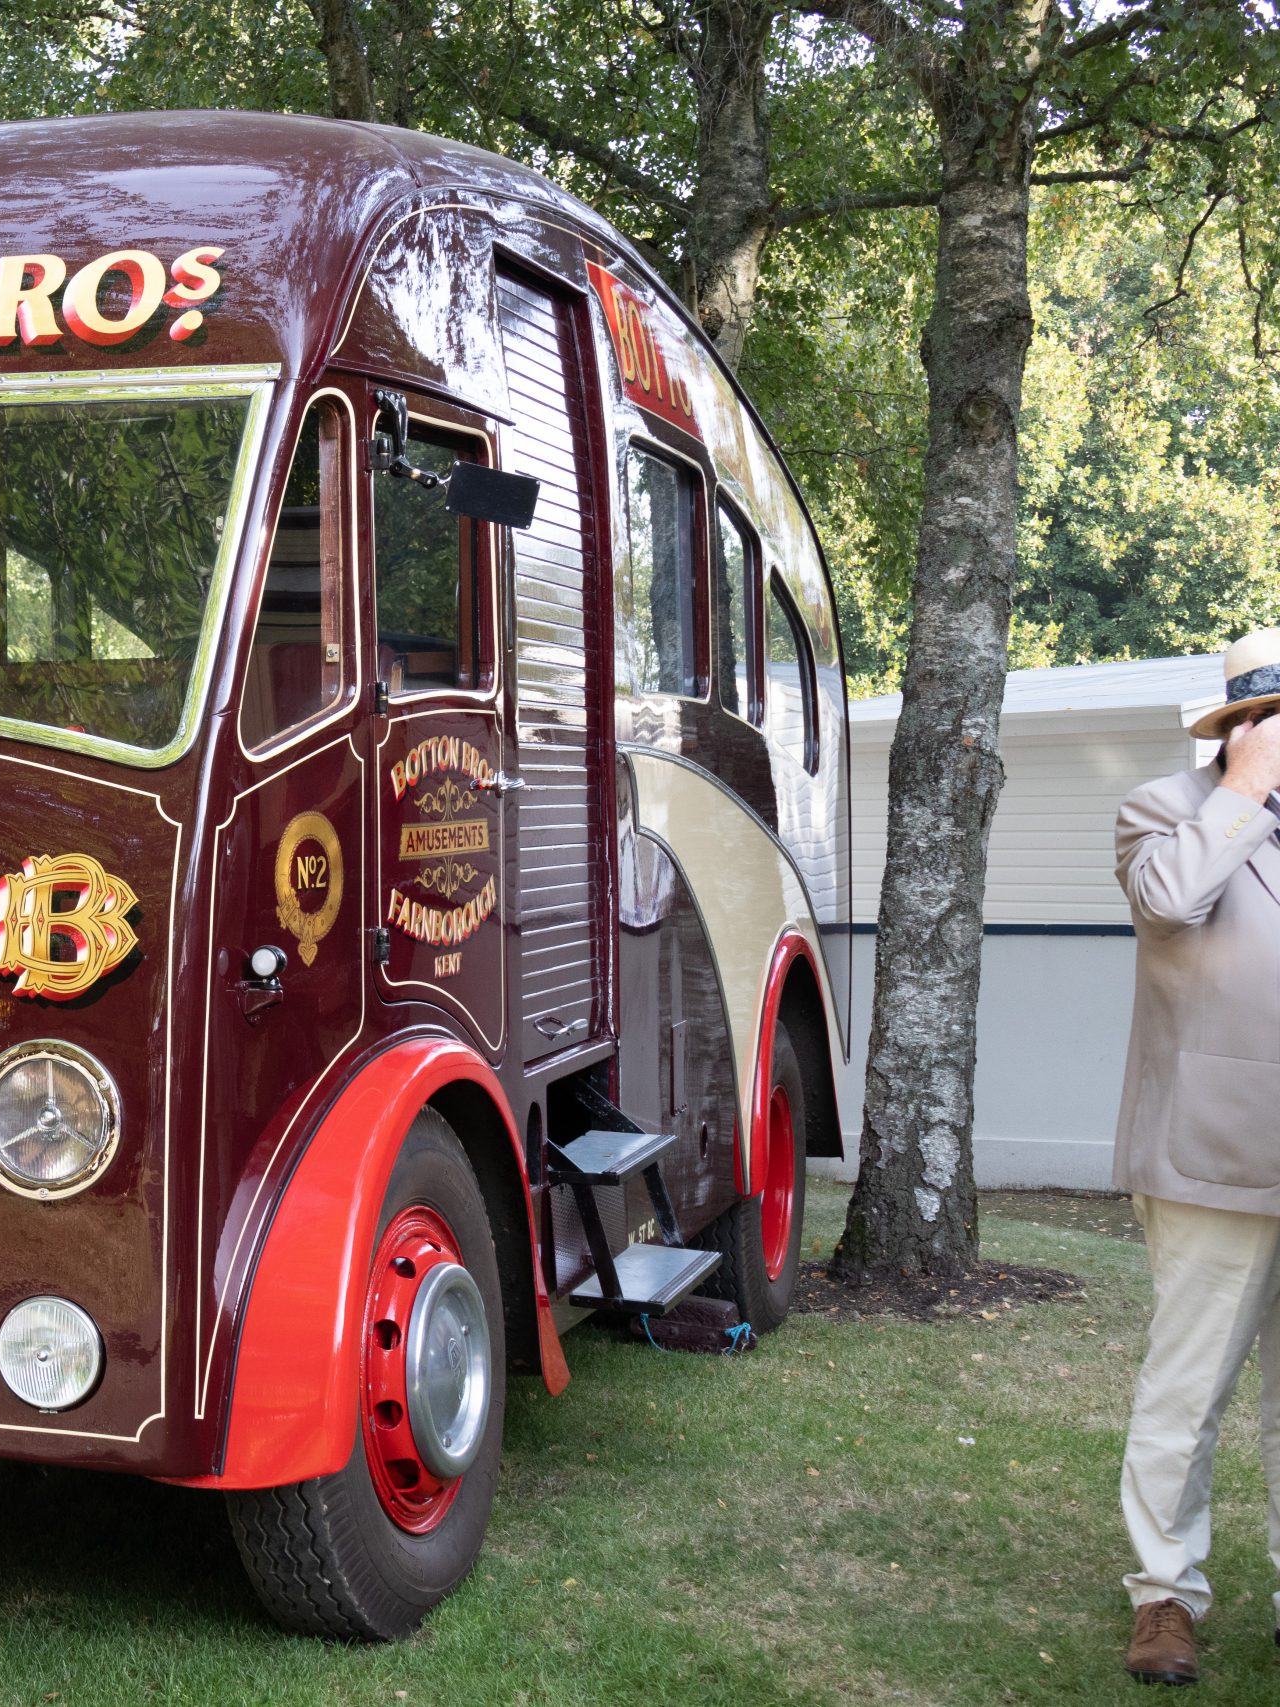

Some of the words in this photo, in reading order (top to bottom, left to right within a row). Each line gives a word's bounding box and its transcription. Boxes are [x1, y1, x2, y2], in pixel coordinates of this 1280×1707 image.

[391, 735, 460, 801] BOTTON
[406, 825, 484, 853] AMUSEMENTS
[387, 875, 496, 946] FARNBOROUGH
[434, 952, 463, 978] KENT
